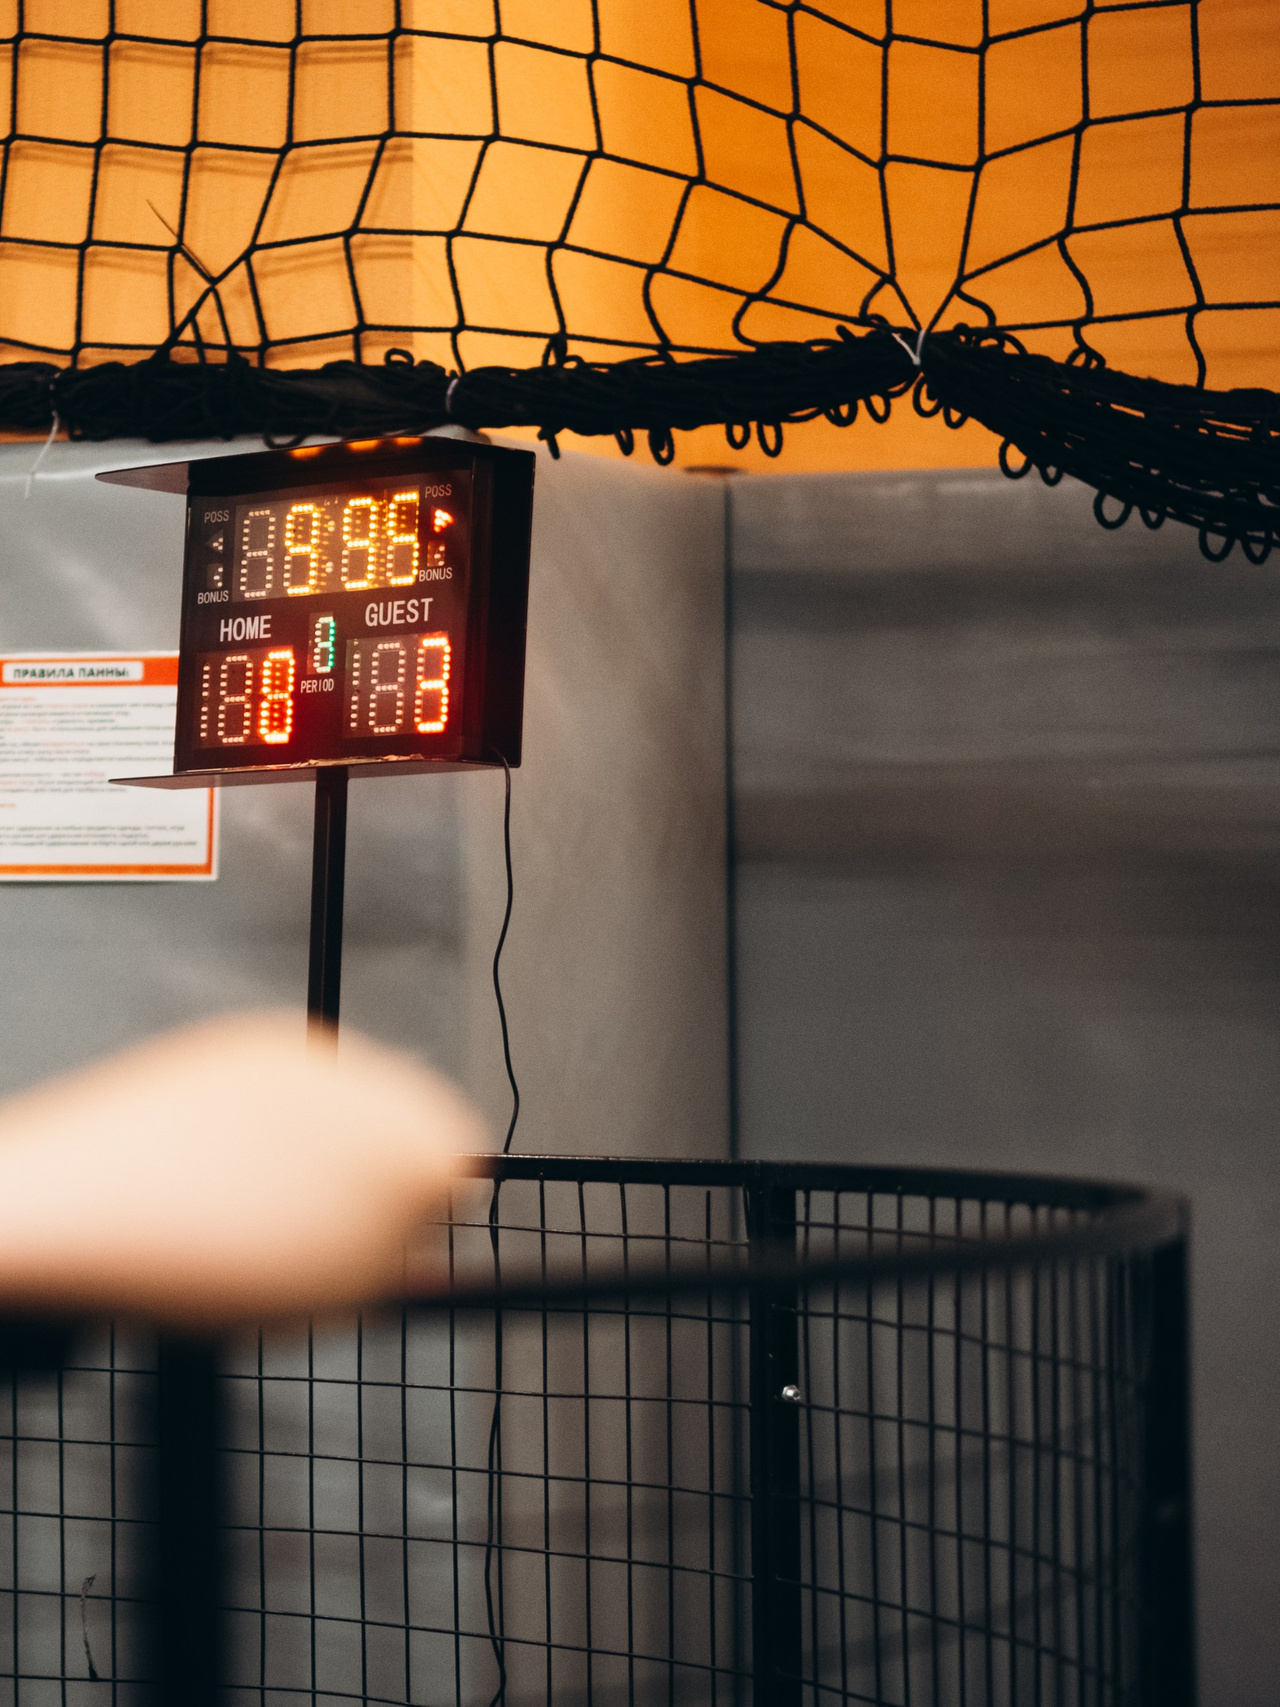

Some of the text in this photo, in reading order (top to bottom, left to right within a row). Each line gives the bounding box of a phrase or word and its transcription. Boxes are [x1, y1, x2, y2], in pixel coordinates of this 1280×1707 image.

[424, 484, 452, 499] POSS
[204, 509, 230, 524] POSS
[418, 567, 453, 583] BONUS
[197, 589, 229, 604] BONUS
[365, 598, 434, 627] GUEST
[220, 614, 272, 642] HOME
[13, 667, 74, 679] ПРАВИЛА
[300, 678, 334, 693] PERIOD
